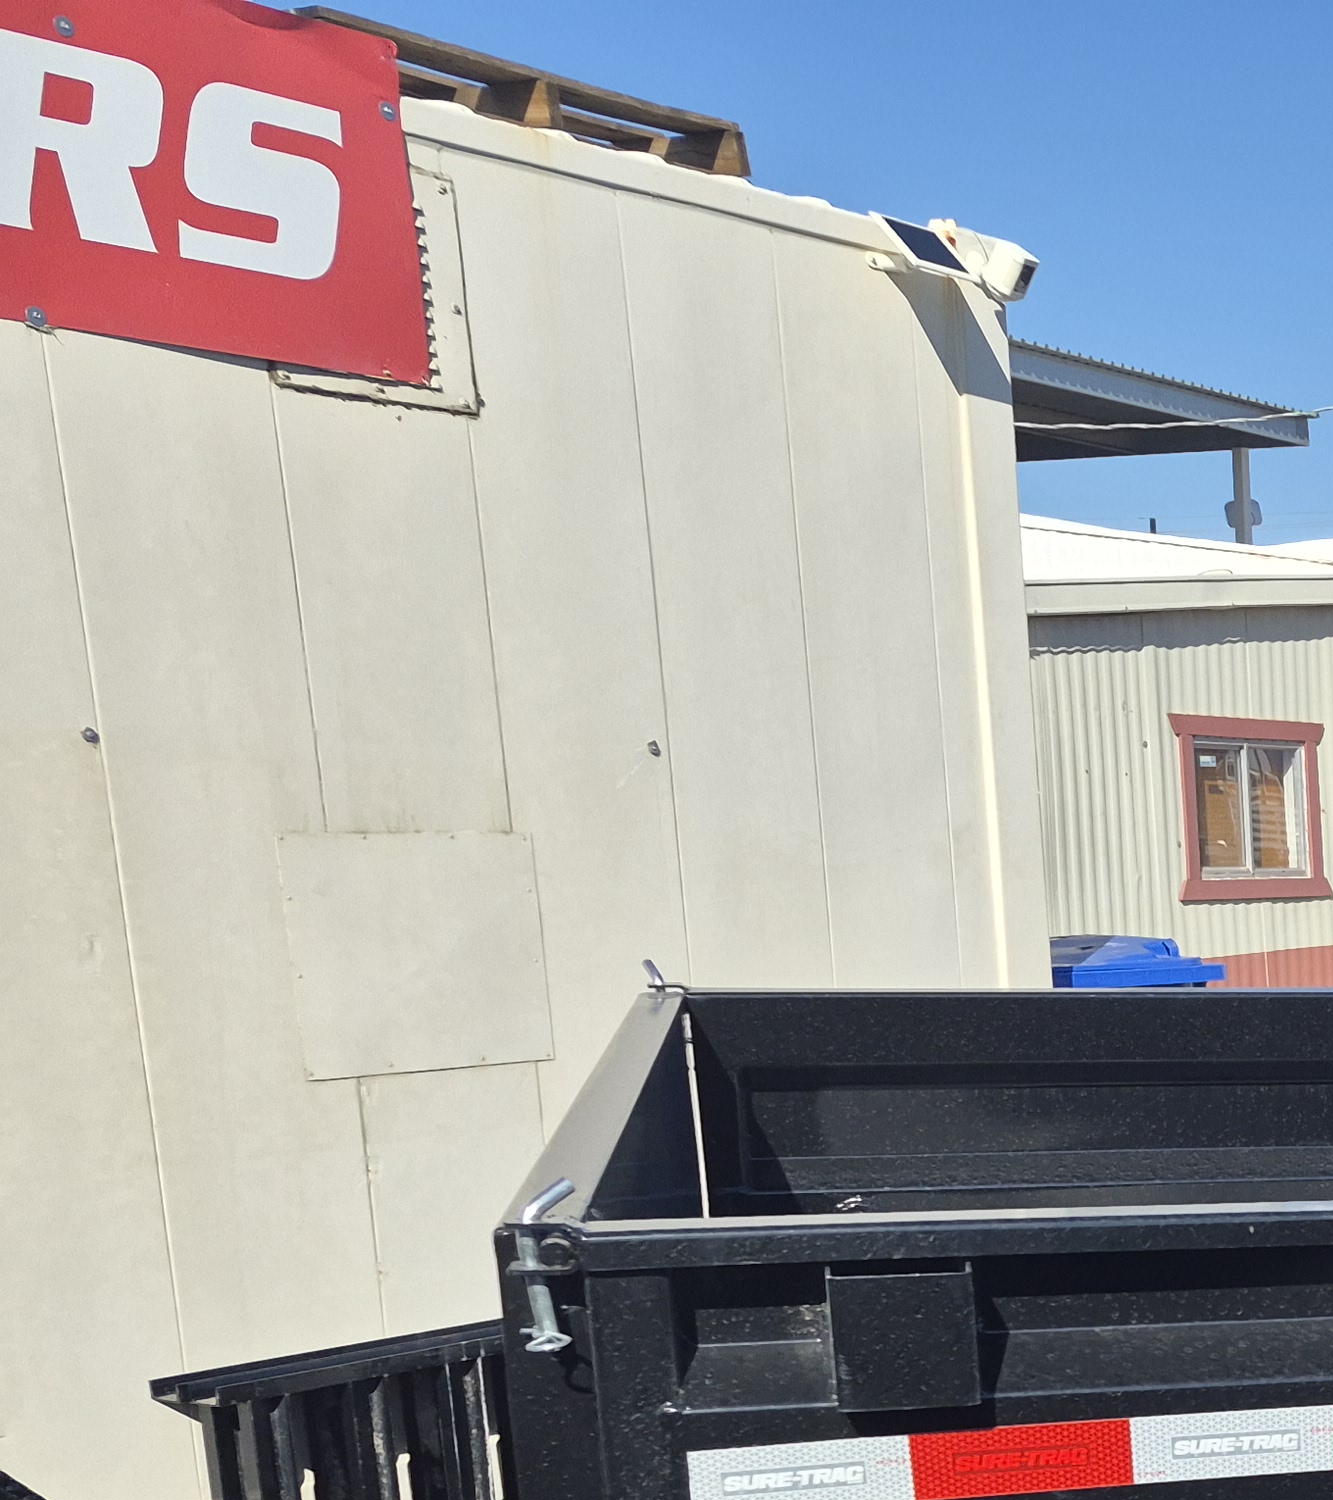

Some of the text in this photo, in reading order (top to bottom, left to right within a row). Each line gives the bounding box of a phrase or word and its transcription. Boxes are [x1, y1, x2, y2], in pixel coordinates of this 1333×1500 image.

[1174, 1433, 1298, 1457] SURE-TRAC
[956, 1447, 1088, 1473] SURE-TRAC
[723, 1463, 864, 1493] SURE-TRAC
